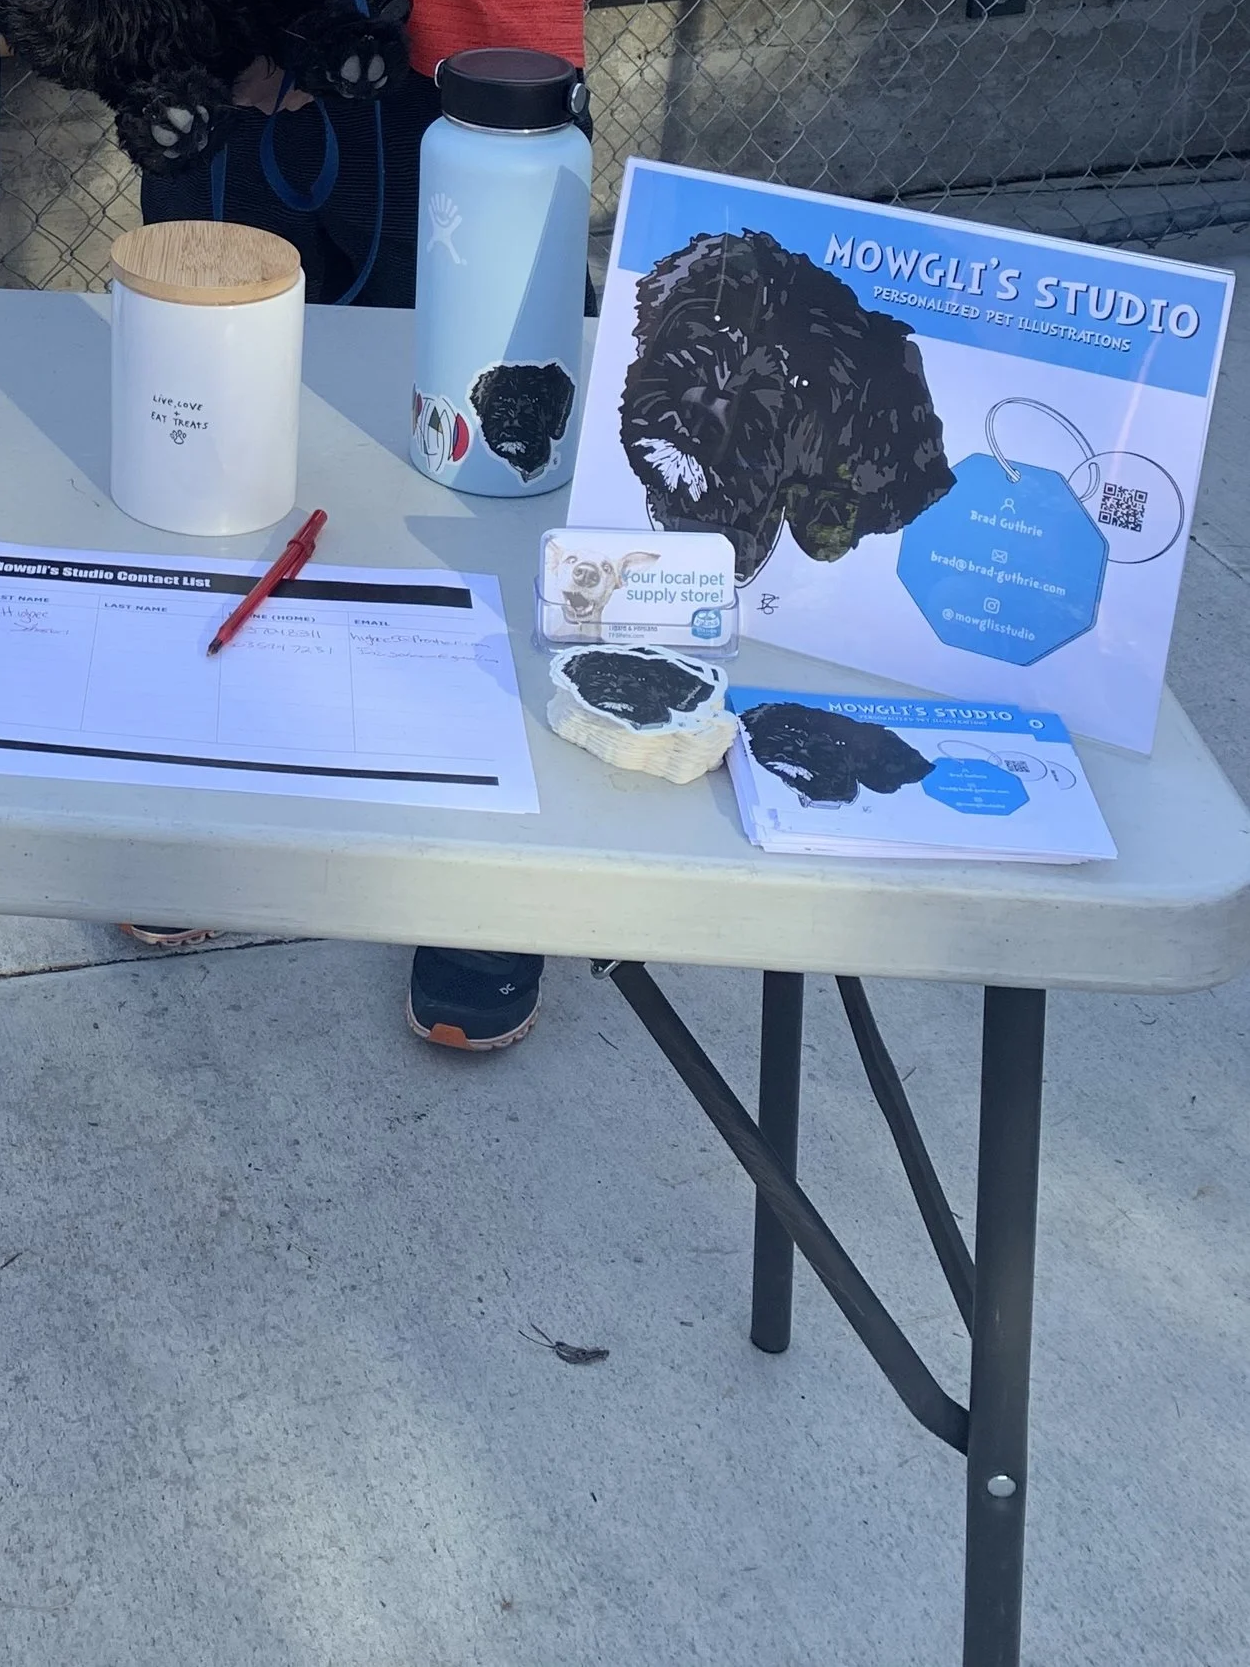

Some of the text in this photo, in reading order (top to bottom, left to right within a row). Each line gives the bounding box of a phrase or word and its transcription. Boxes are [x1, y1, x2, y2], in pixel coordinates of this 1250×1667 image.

[824, 234, 1200, 339] MOWGLI'S STUDIO
[873, 285, 1131, 352] PERSONALIZED PET ILLUSTRATIONS
[151, 411, 167, 423] EAT
[970, 509, 1043, 537] Brad Guthrie
[62, 566, 114, 580] Studio
[117, 571, 180, 585] Contact
[182, 576, 211, 588] List
[621, 570, 725, 588] Your local pet
[19, 595, 50, 603] NAME
[626, 588, 724, 603] supply store!
[104, 602, 168, 613] LAST NAME
[354, 619, 391, 627] EMAIL
[942, 608, 1035, 642] @mowglisstudio
[828, 702, 1014, 722] MOWGLI'S STUDIO
